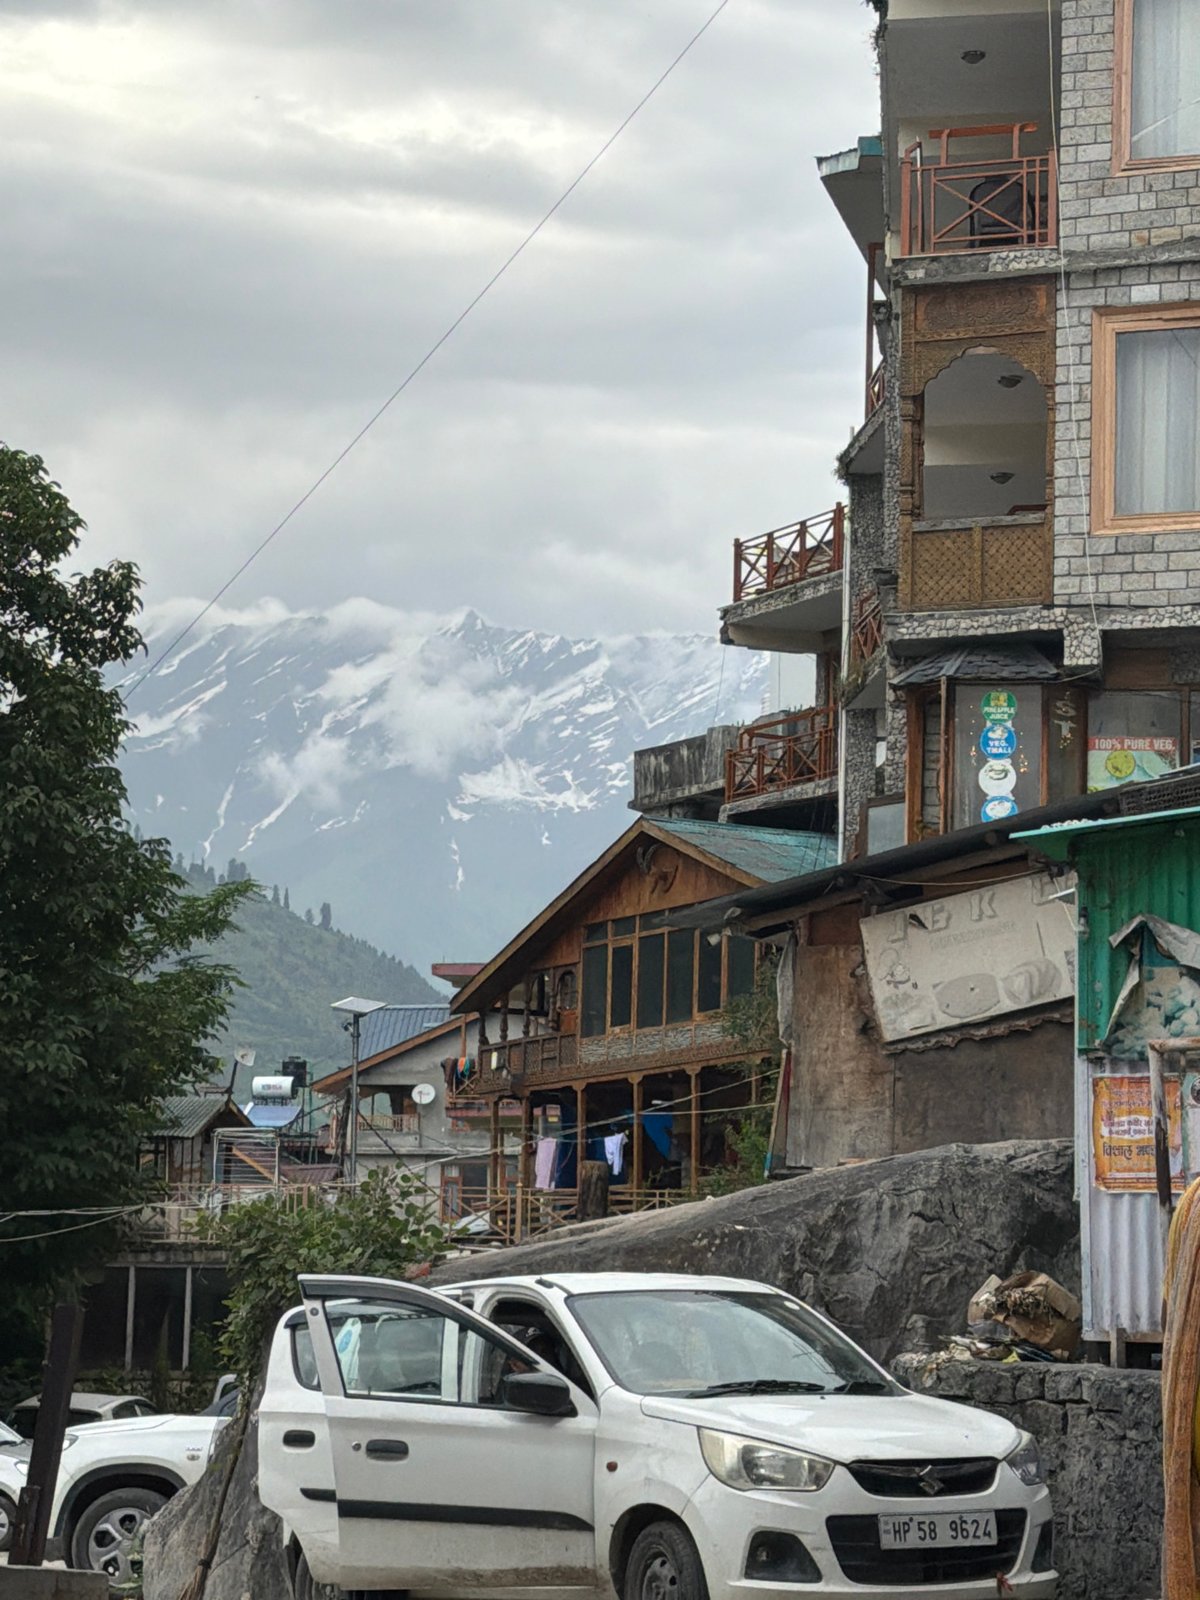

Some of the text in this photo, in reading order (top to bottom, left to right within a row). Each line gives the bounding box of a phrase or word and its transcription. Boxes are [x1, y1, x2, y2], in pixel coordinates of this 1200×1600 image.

[1094, 738, 1176, 750] 100% PURE VEG.
[1103, 1142, 1133, 1160] विशाल
[892, 1520, 911, 1543] HP
[917, 1520, 938, 1542] 58
[949, 1518, 992, 1541] 9624
